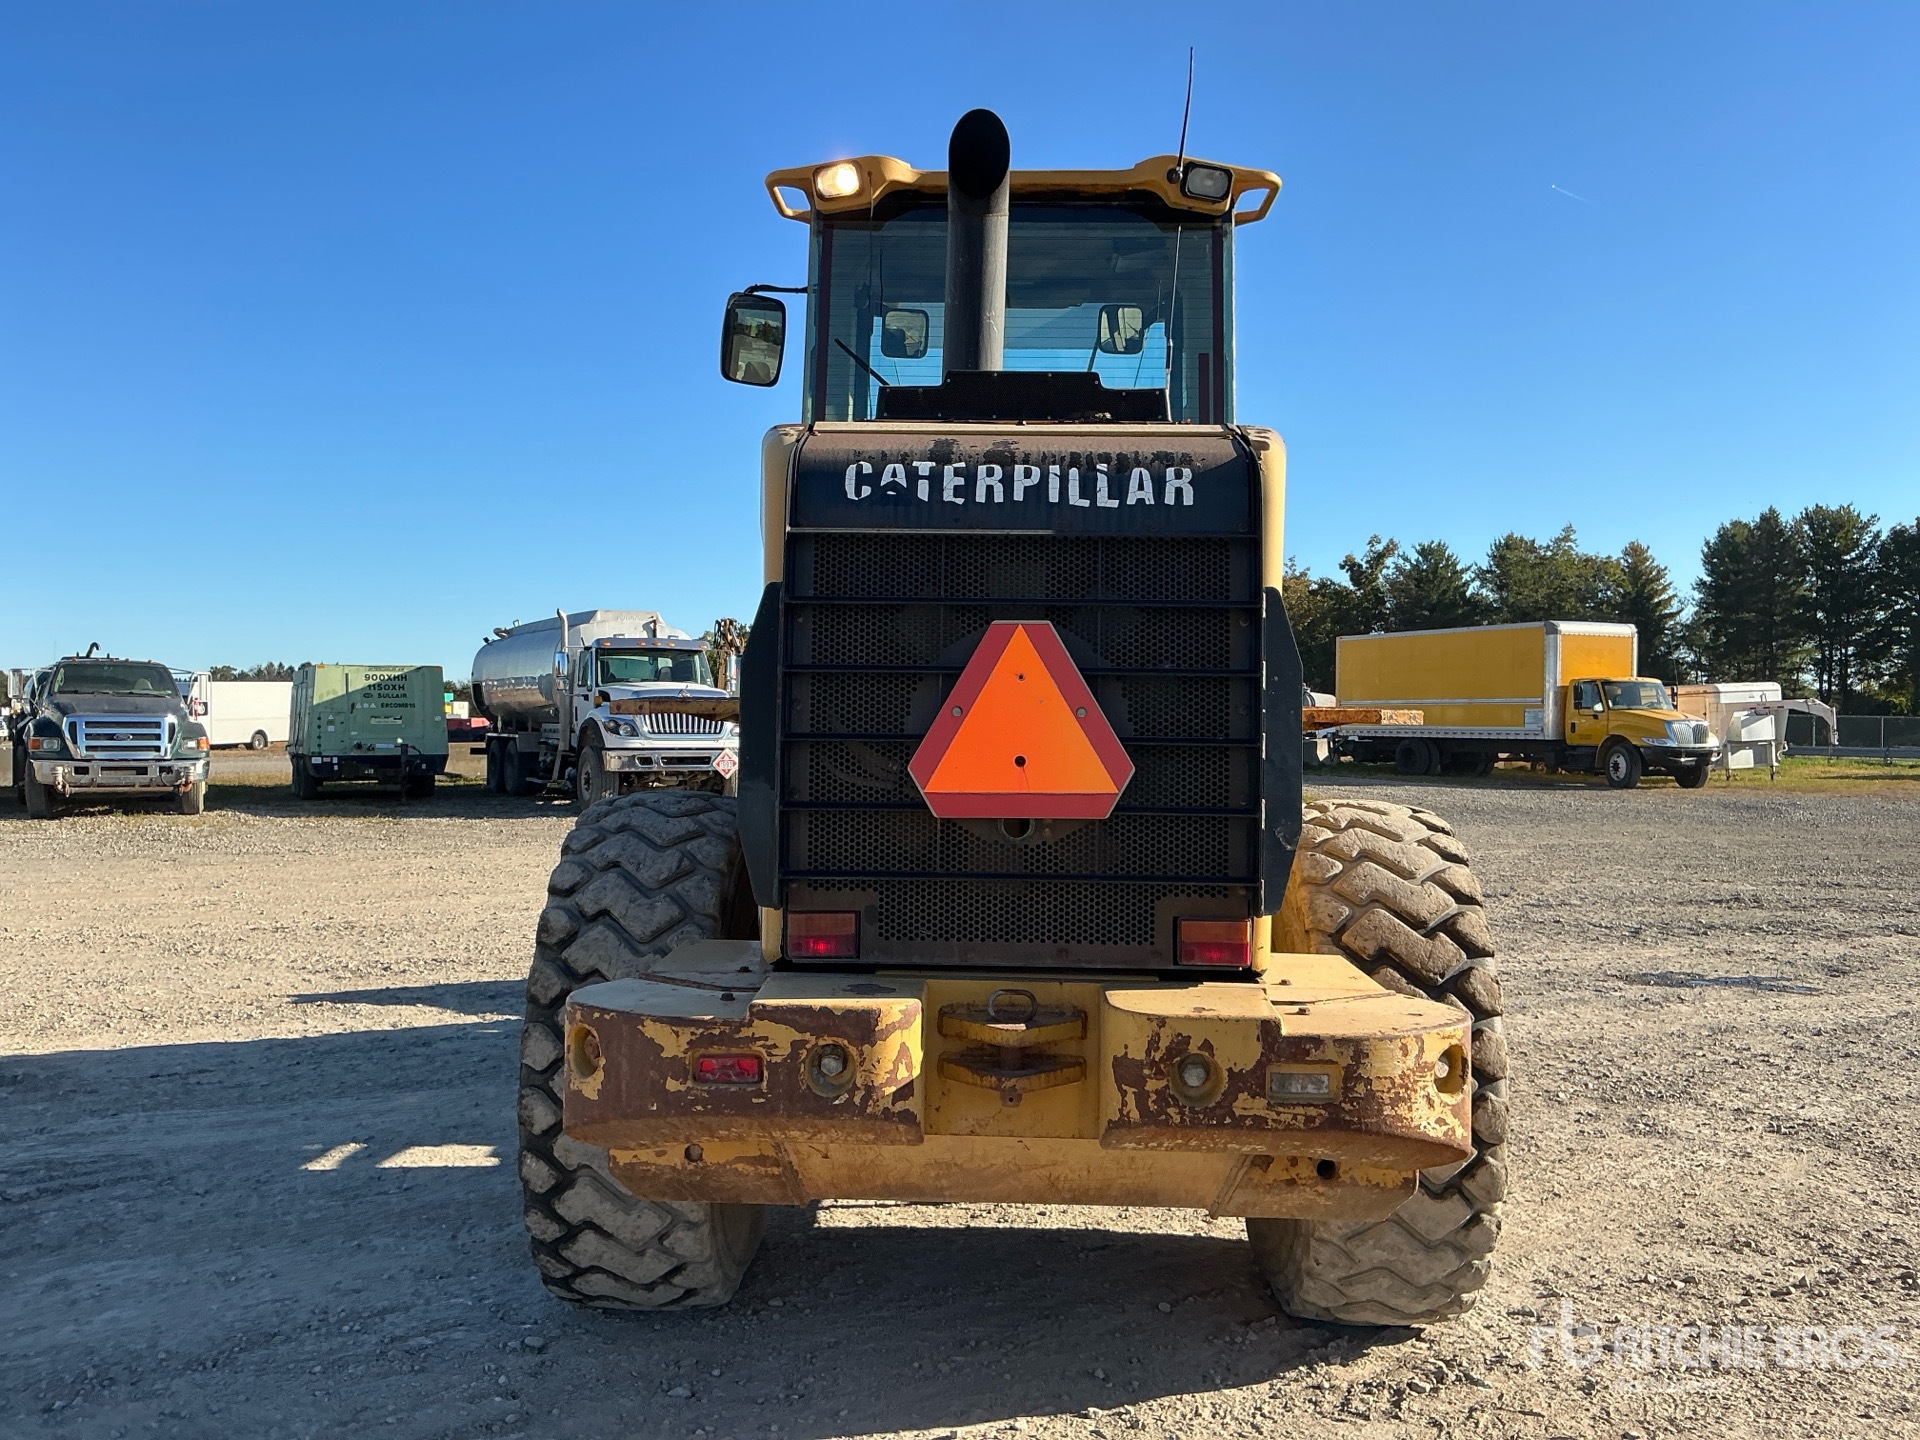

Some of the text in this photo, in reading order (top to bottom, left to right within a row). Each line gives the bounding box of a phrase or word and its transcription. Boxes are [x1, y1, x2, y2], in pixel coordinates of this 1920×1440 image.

[845, 460, 1194, 508] CATERPILLAR
[364, 673, 408, 682] 900XHH
[367, 683, 405, 691] 1150XH
